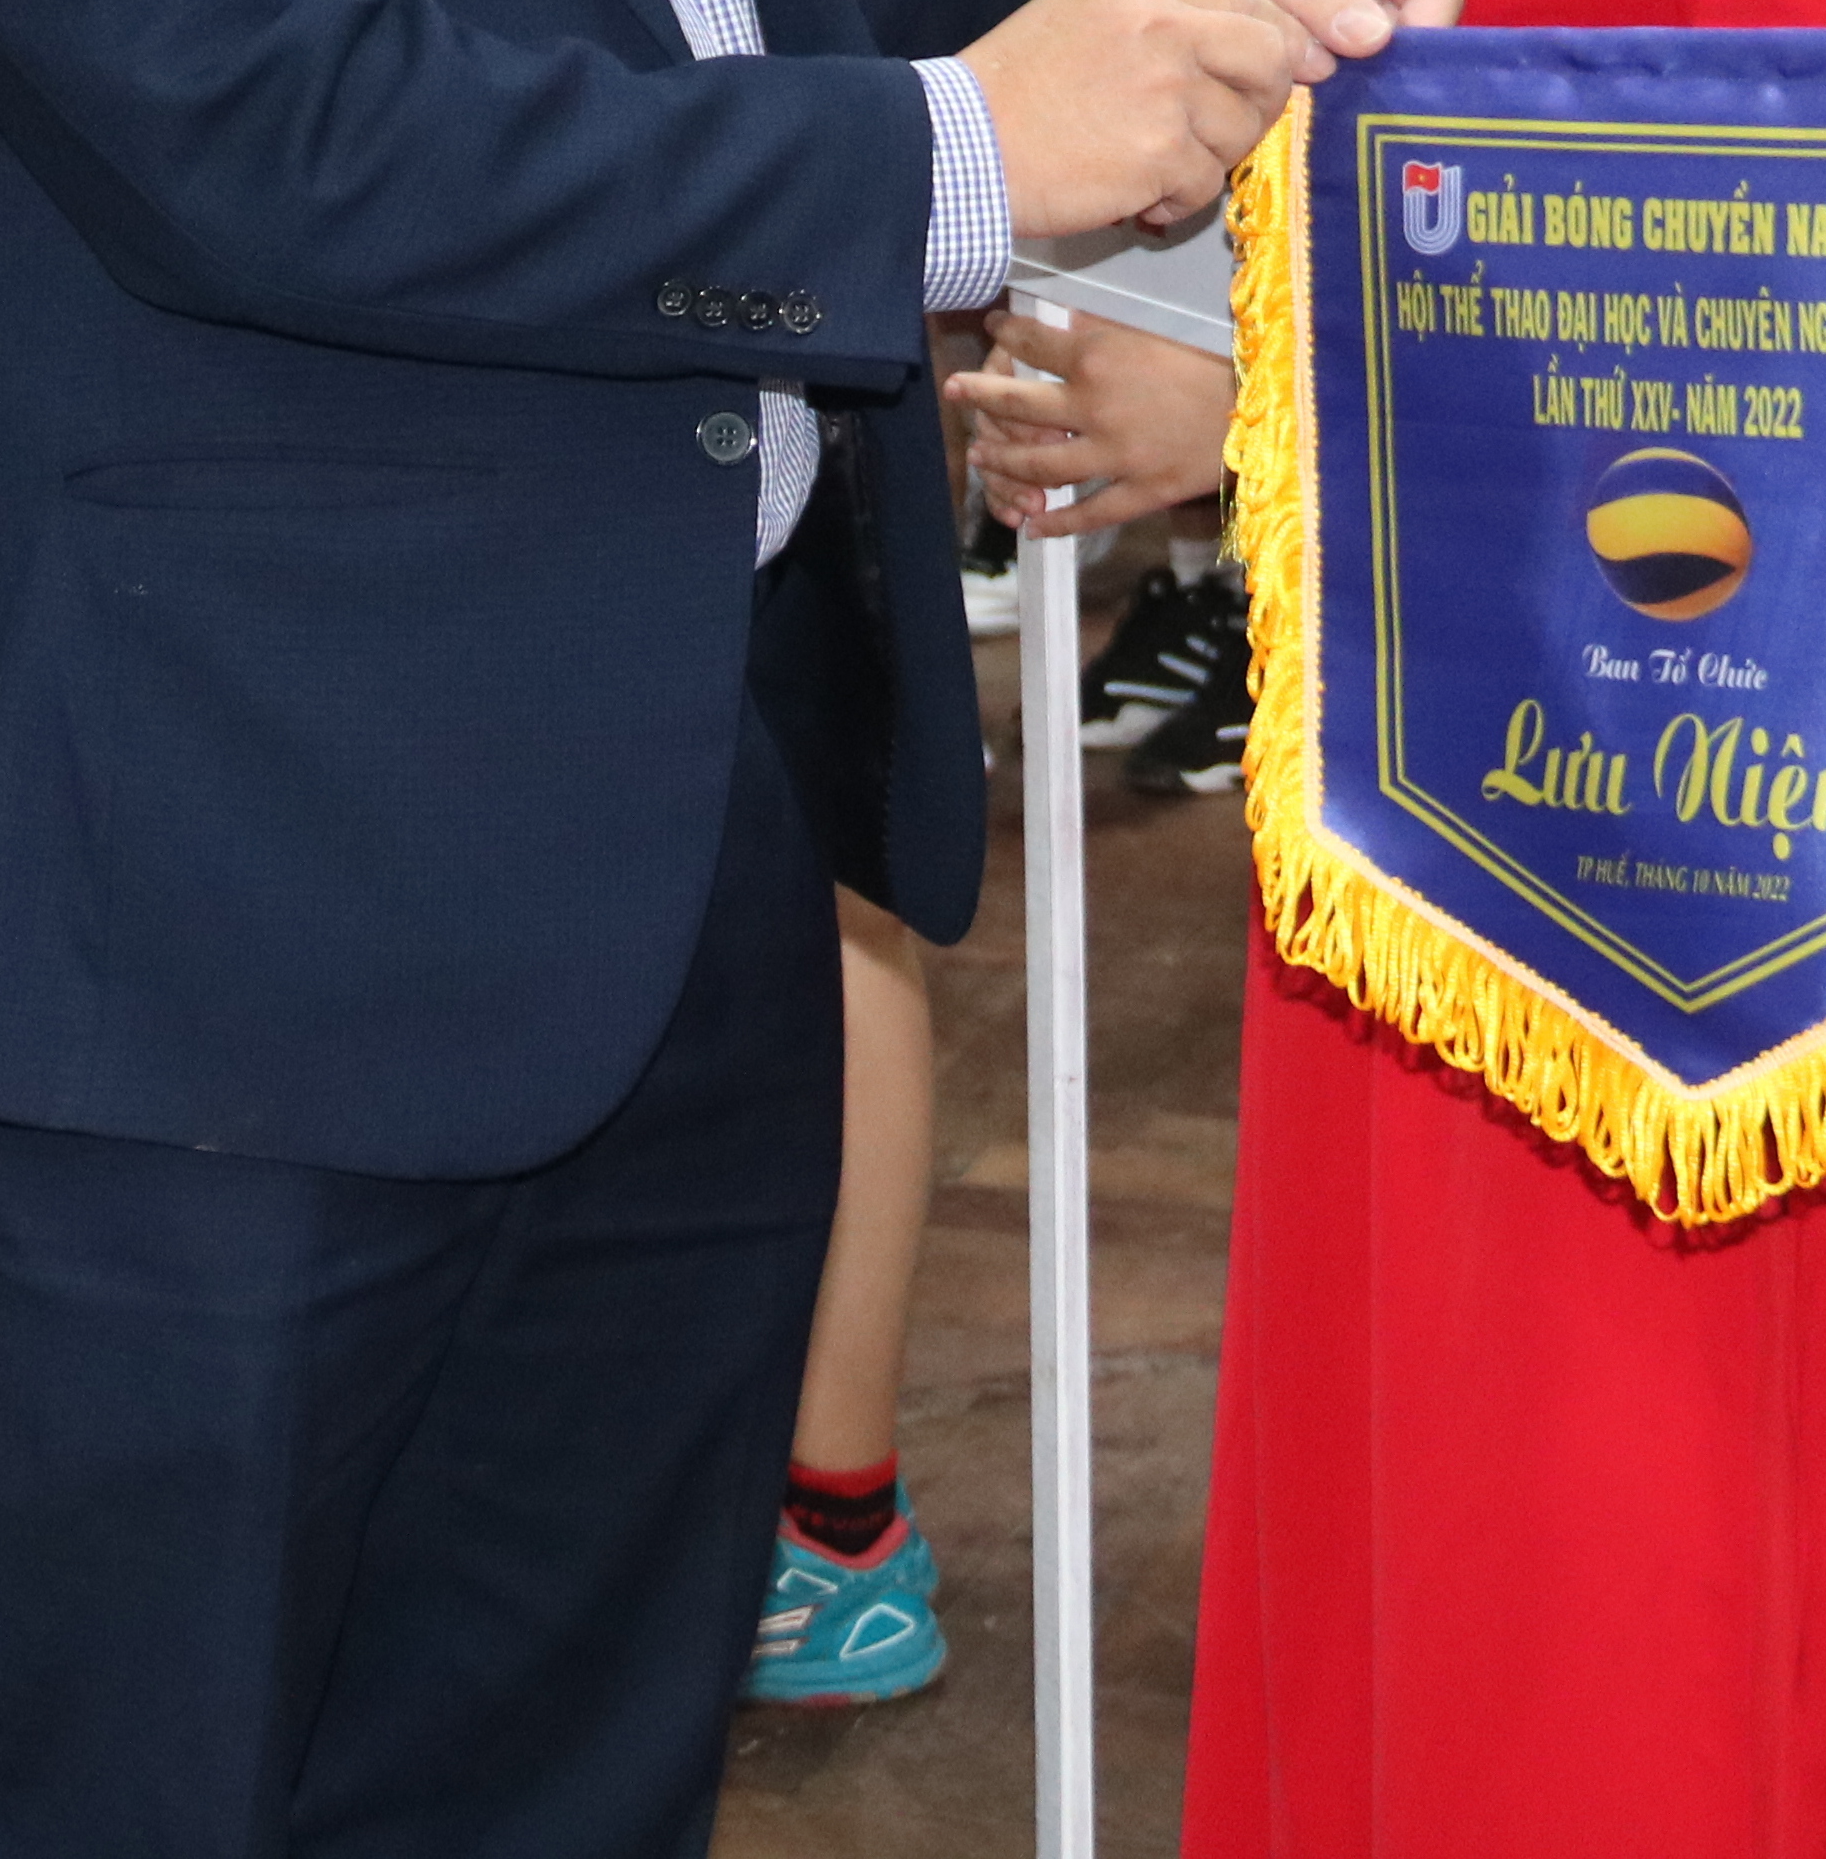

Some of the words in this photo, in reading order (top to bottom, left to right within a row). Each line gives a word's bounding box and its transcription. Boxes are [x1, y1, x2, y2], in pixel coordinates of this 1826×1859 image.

[1467, 173, 1534, 245] GIẢI
[1544, 180, 1634, 250] BÓNG
[1642, 179, 1776, 255] CHUYỀN
[1396, 269, 1436, 343] HỘI
[1439, 259, 1485, 337] THỂ
[1490, 287, 1552, 341] THAO
[1556, 290, 1598, 353] ĐẠI
[1604, 292, 1652, 355] HỌC
[1657, 281, 1689, 348] VÀ
[1695, 285, 1793, 352] CHUYÊN
[1533, 353, 1576, 427] LẦN
[1580, 363, 1627, 431] THỨ
[1686, 373, 1737, 437] NĂM
[1743, 385, 1805, 439] 2022
[1582, 643, 1641, 682] Ban
[1481, 698, 1633, 816] Lưu
[1577, 855, 1594, 881] TP
[1693, 869, 1711, 894] 10
[1715, 866, 1751, 898] NĂM
[1751, 873, 1791, 903] 2022
